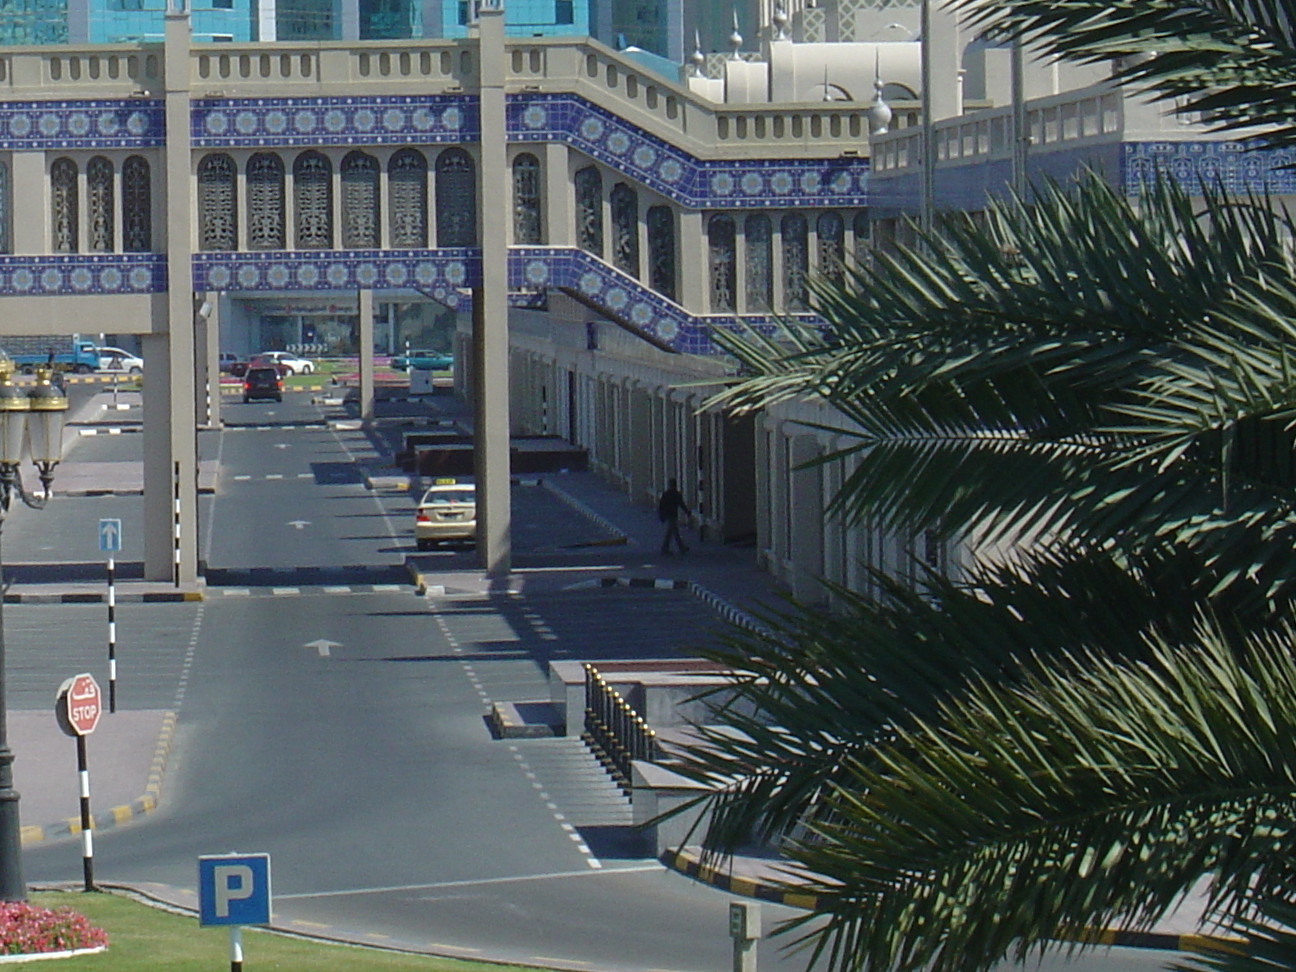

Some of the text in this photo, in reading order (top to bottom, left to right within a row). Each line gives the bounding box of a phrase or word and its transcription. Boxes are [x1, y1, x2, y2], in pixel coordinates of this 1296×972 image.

[72, 679, 96, 700] قف
[73, 705, 97, 721] STOP
[214, 865, 253, 917] P
